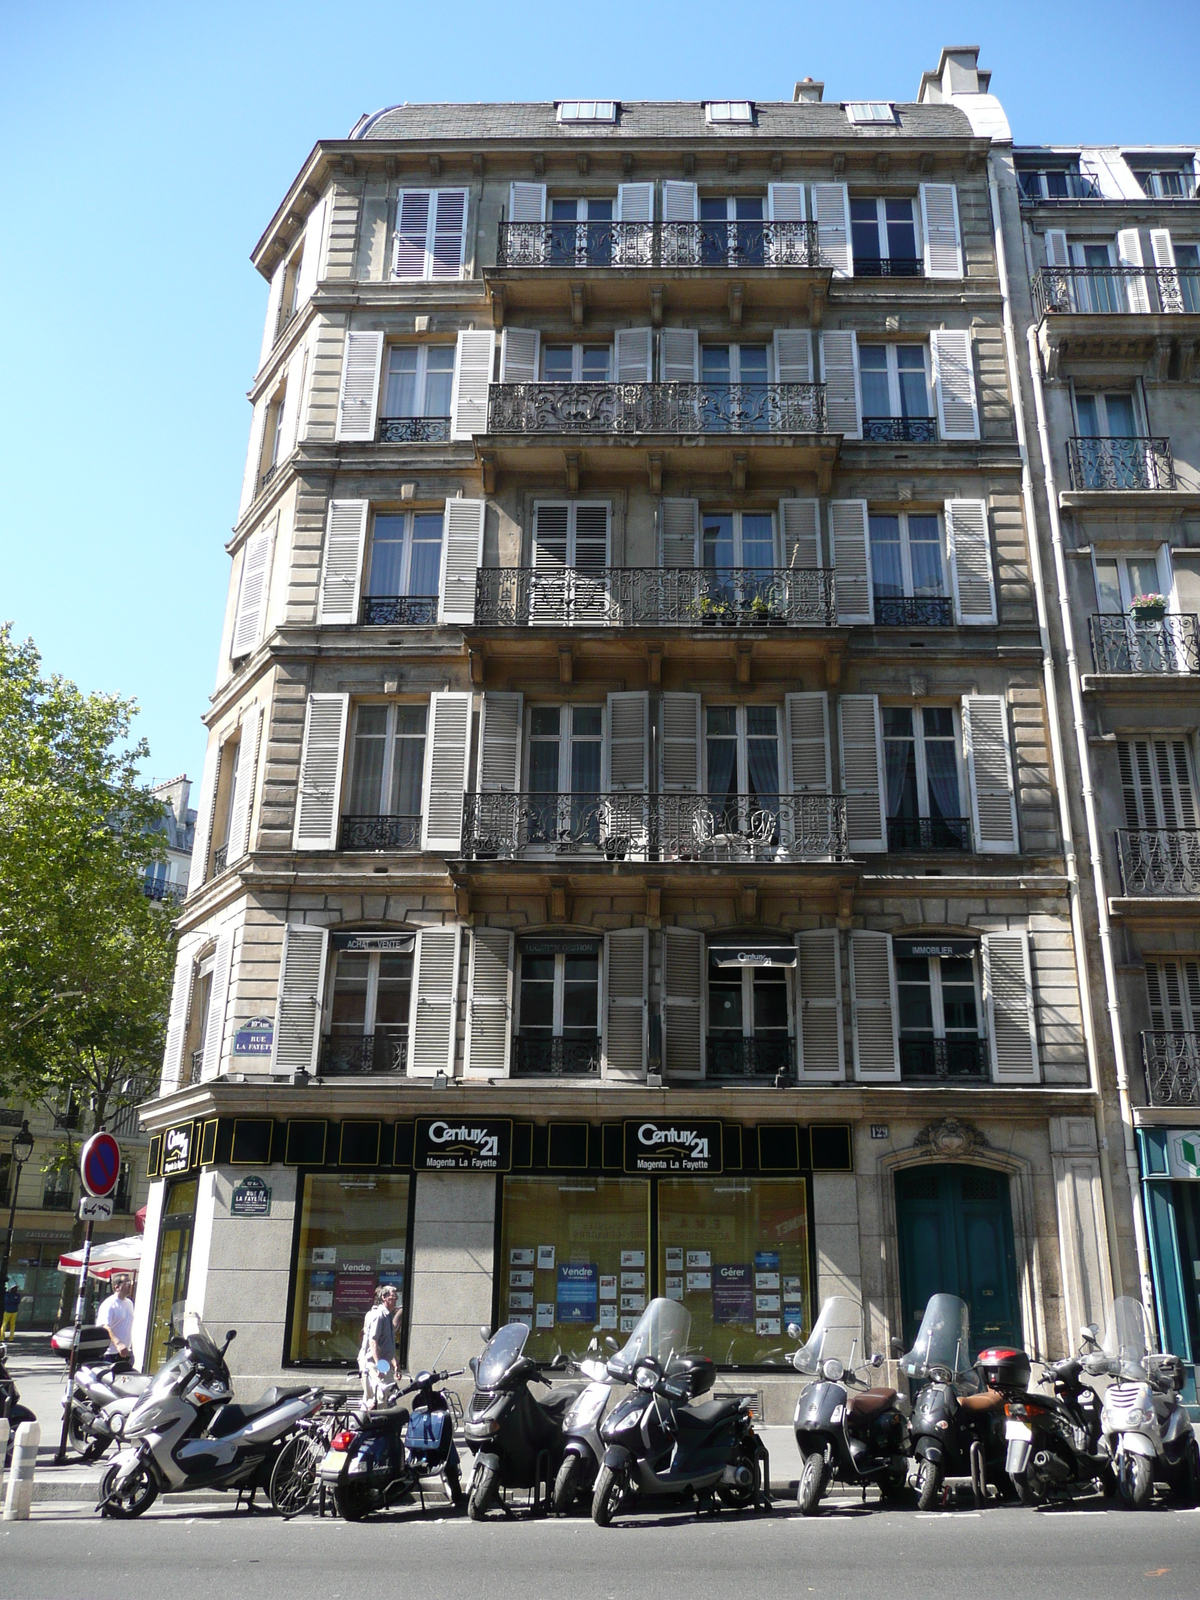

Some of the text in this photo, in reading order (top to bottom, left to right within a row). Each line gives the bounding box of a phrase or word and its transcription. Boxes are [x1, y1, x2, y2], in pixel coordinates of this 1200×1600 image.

[347, 941, 401, 949] ACHAT VENTE
[562, 944, 593, 952] GESTION
[912, 946, 953, 954] IMMOBILIER
[737, 952, 766, 962] Century
[872, 1126, 888, 1138] 129
[428, 1121, 498, 1156] Century 21
[637, 1123, 709, 1158] Century 21
[426, 1158, 497, 1169] Magenta La Fayette
[637, 1160, 708, 1170] Magenta La Fayette
[342, 1263, 371, 1272] Vendre
[562, 1267, 593, 1276] Vendre
[720, 1267, 745, 1276] Gérer
